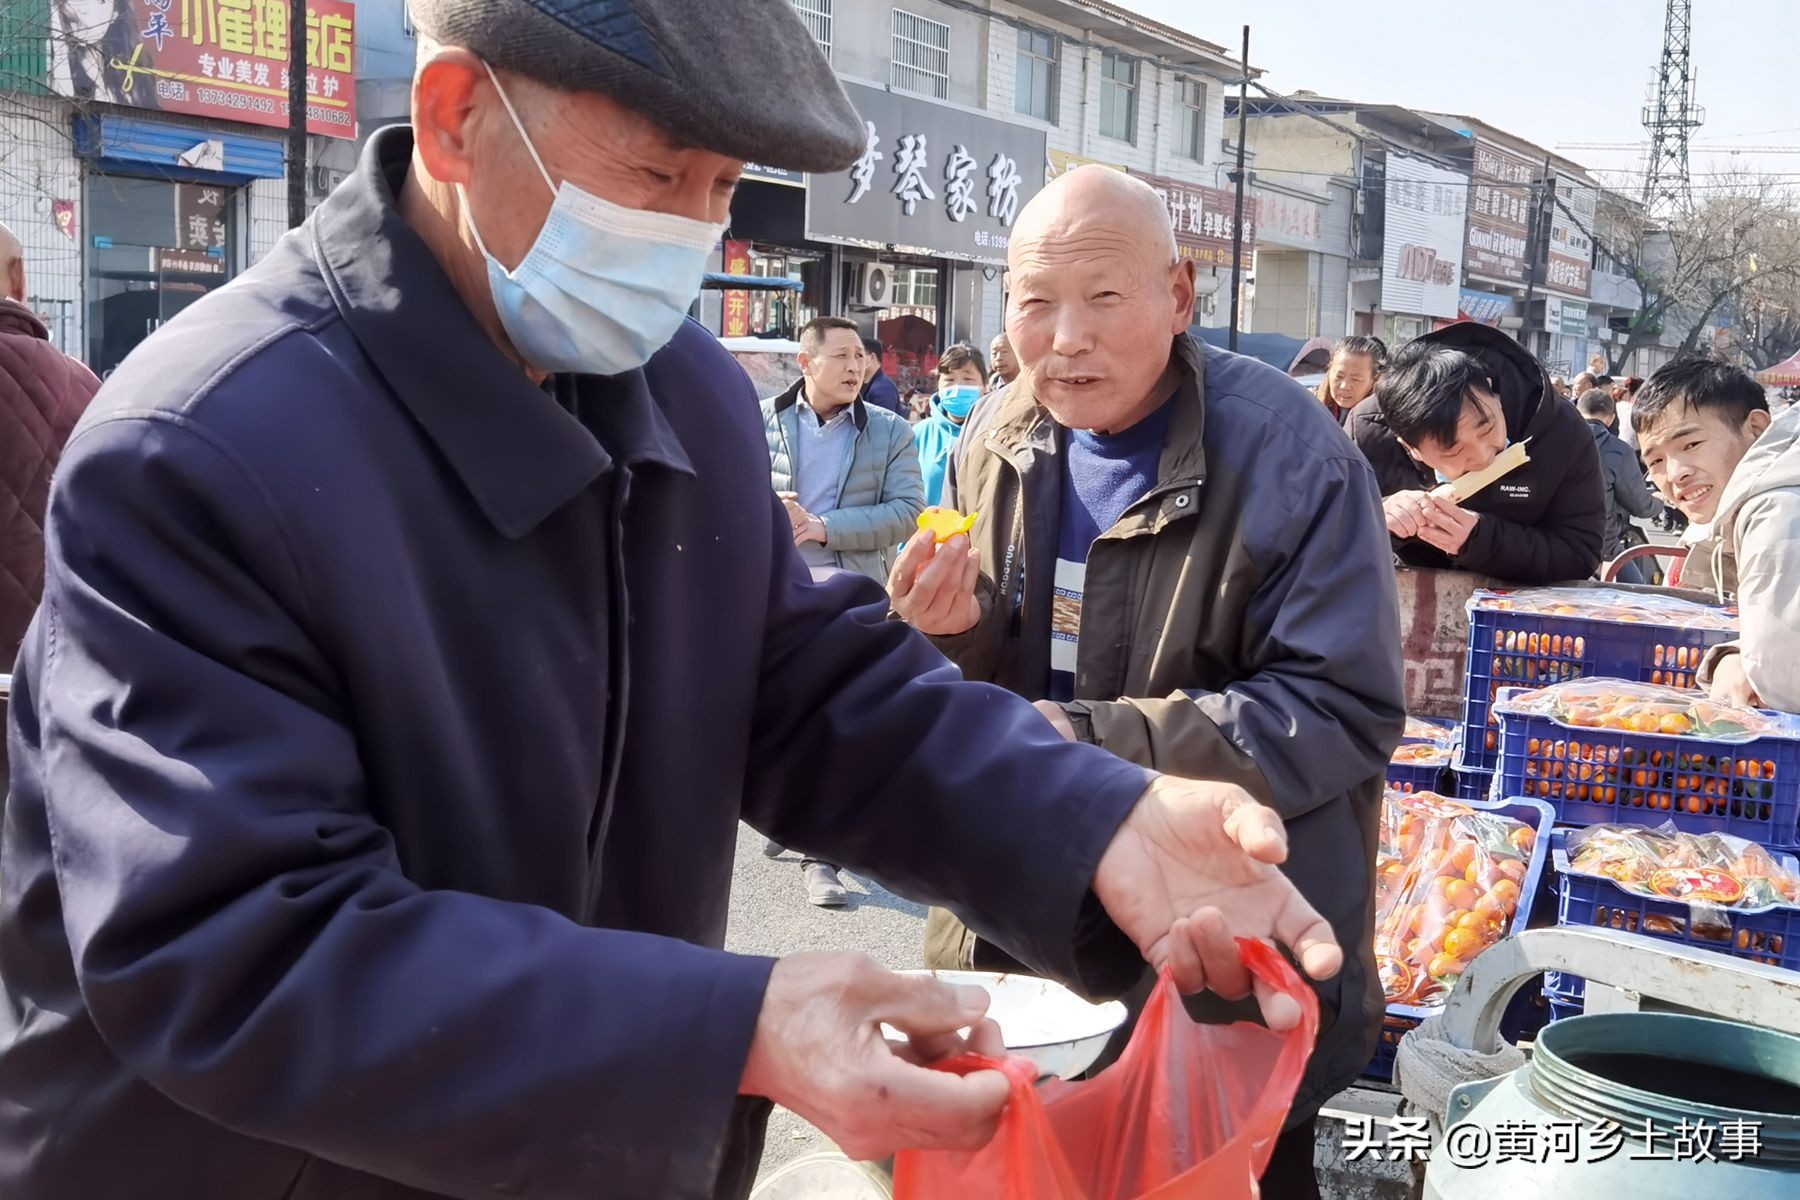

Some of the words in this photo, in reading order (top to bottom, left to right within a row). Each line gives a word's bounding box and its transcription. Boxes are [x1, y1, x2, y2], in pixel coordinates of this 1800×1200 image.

[197, 52, 271, 87] 专业美发
[197, 87, 275, 114] 13734291492
